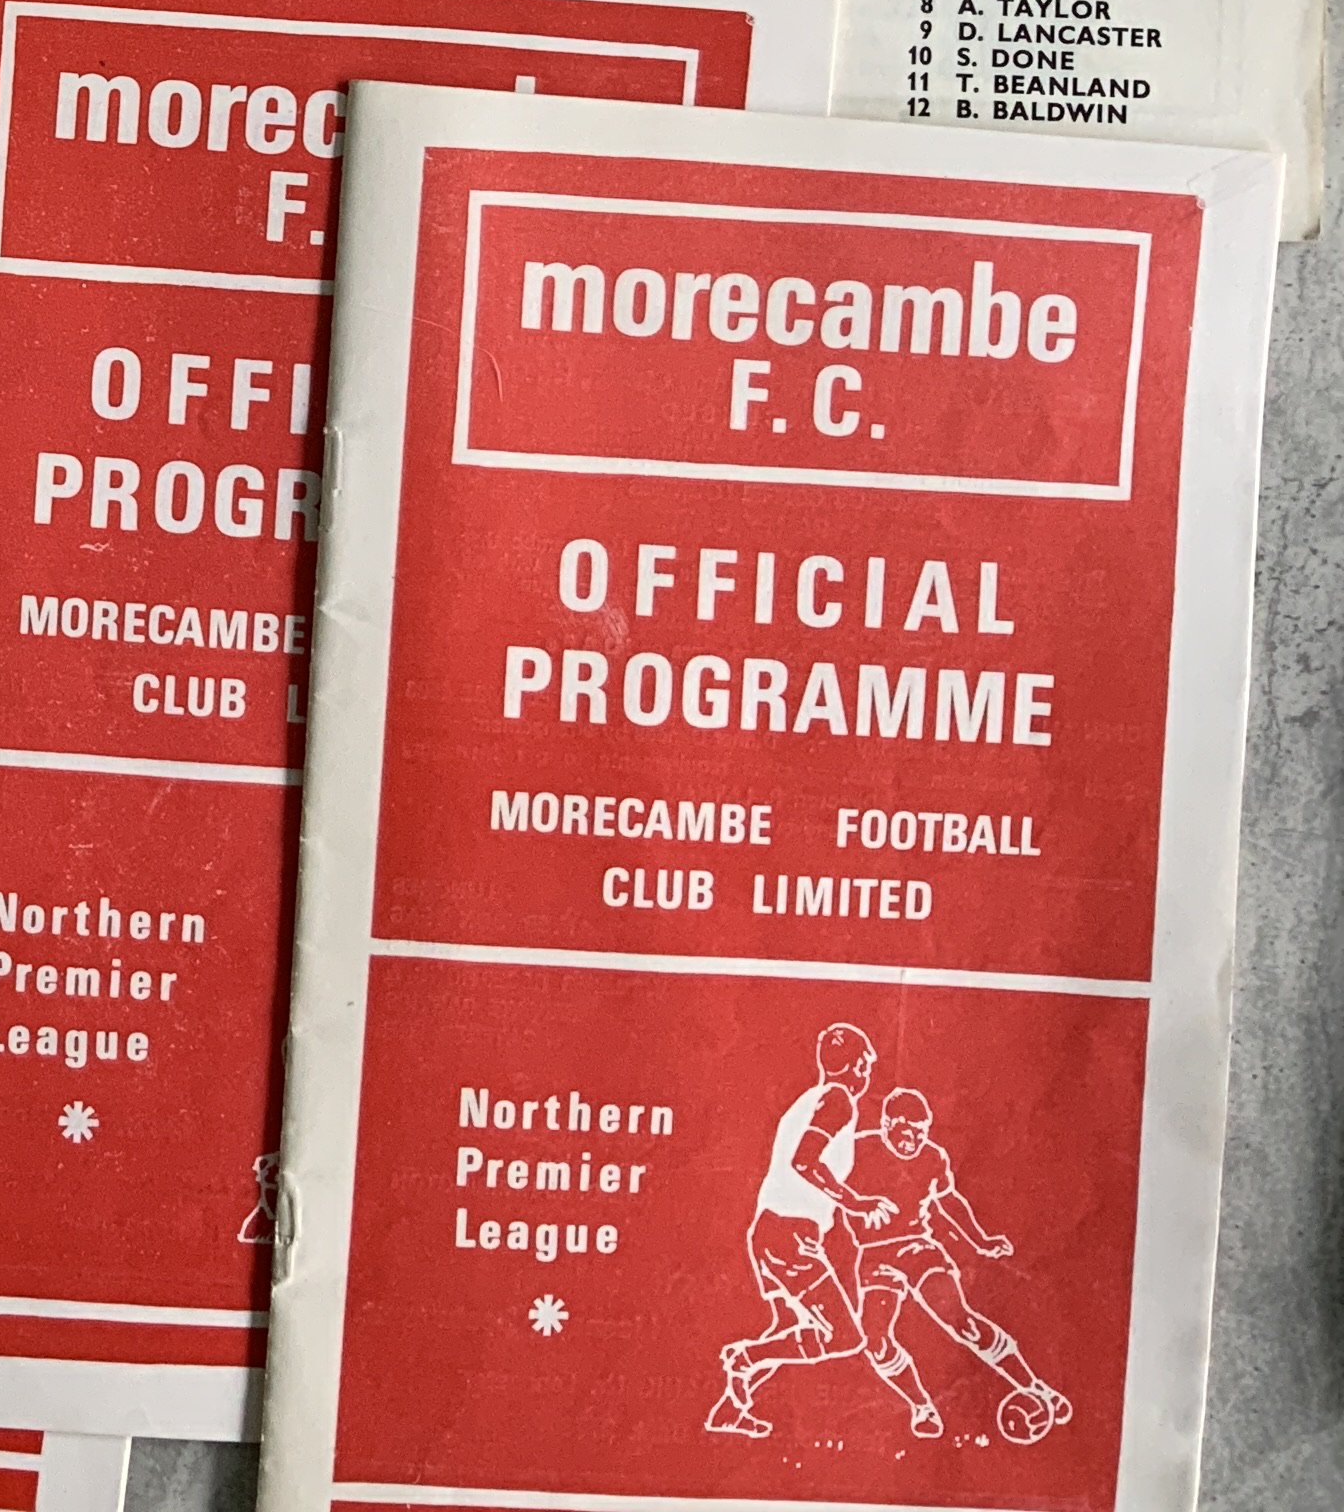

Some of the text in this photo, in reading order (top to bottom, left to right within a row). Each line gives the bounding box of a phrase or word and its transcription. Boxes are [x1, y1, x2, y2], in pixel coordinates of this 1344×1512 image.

[994, 75, 1150, 98] BEANLAND
[522, 261, 1077, 368] morecambe
[560, 539, 1014, 634] OFFICIAL
[504, 646, 1054, 746] PROGRAMME
[491, 791, 1040, 855] MORECAMBE FOOTBALL
[603, 867, 931, 919] CLUB LIMITED
[460, 1088, 673, 1135] Northern
[457, 1147, 646, 1193] Premier
[456, 1208, 617, 1262] League
